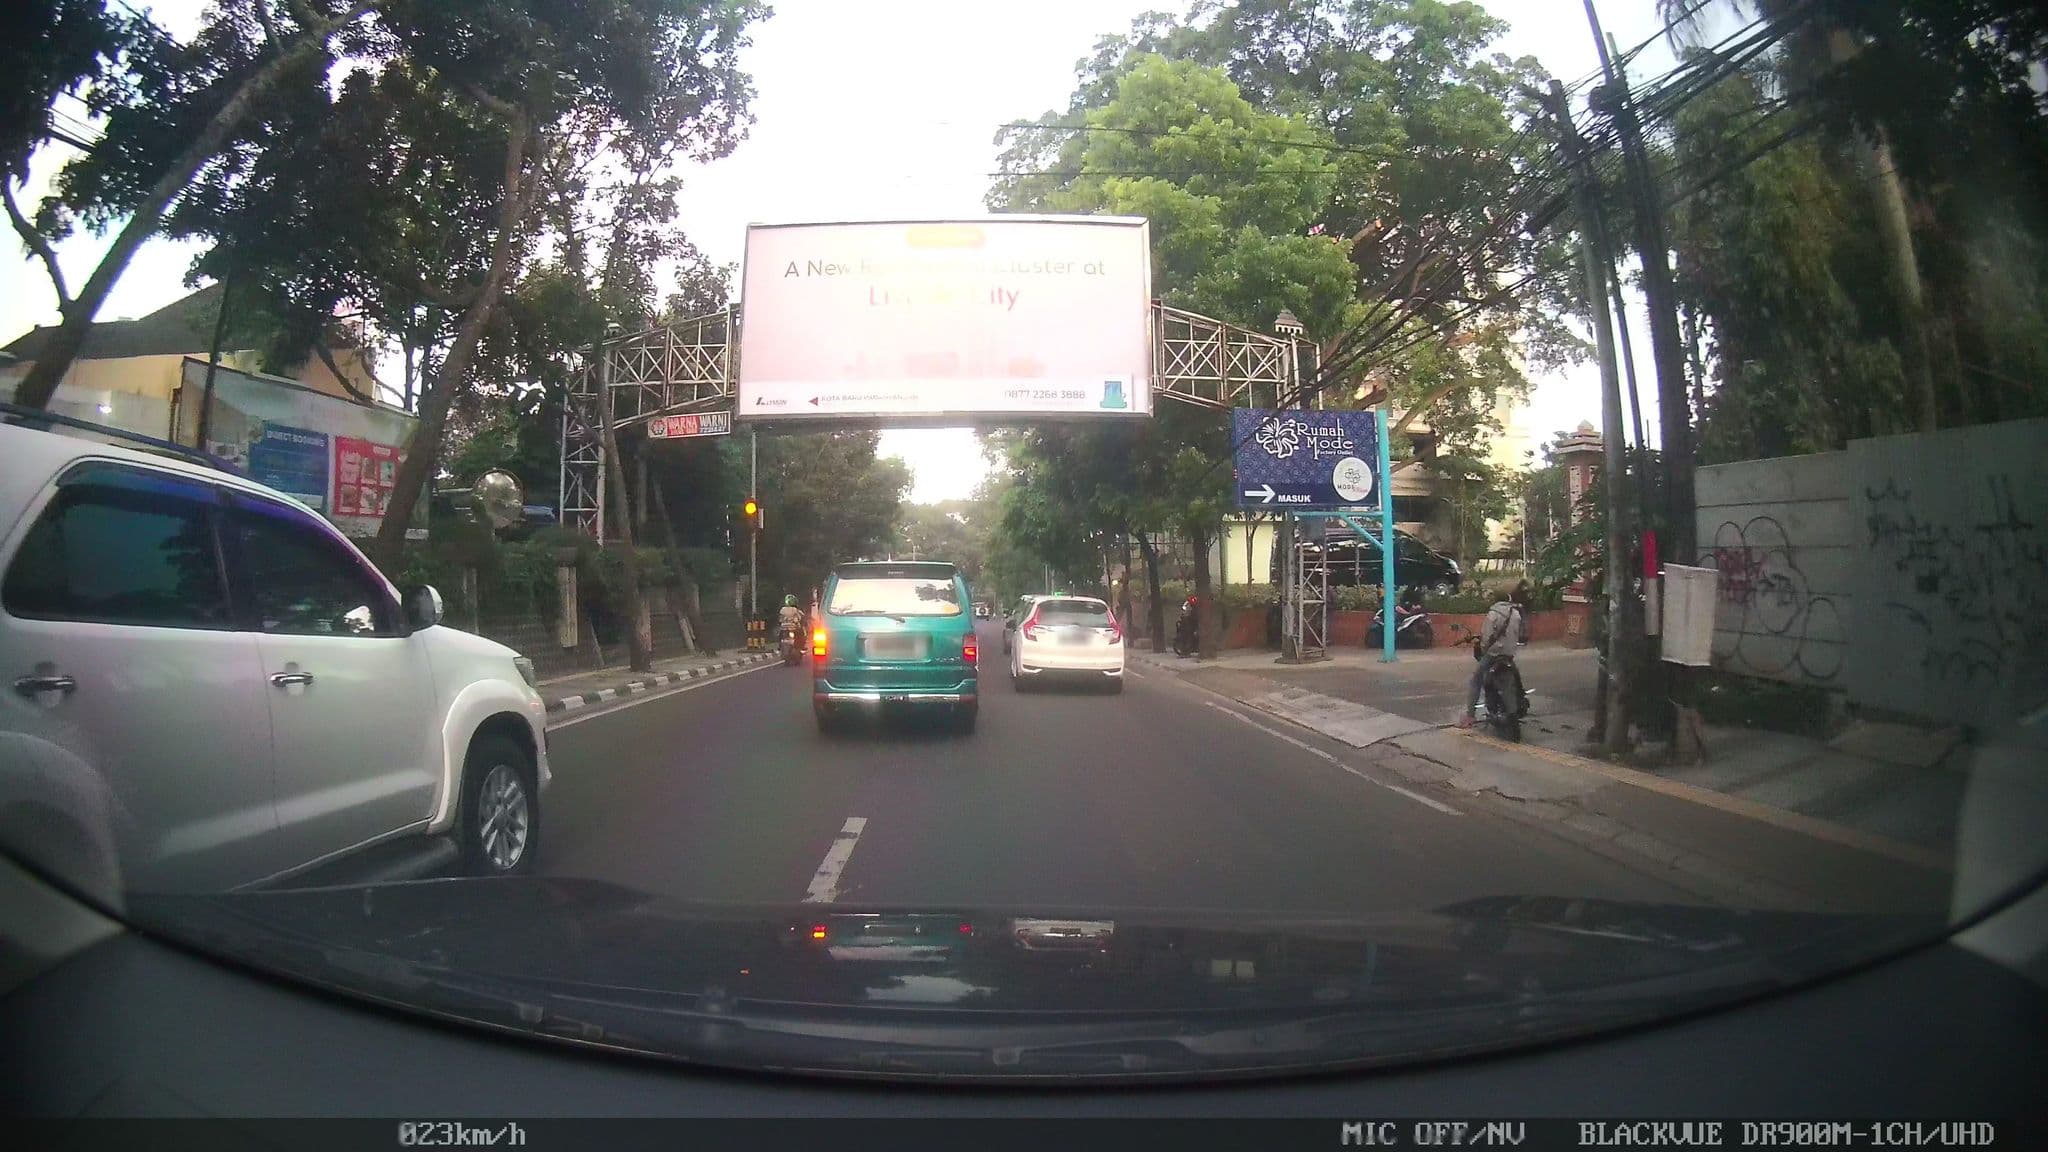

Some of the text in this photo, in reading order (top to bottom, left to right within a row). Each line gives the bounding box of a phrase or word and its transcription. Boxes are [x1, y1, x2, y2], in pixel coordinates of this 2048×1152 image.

[784, 260, 800, 278] A
[807, 259, 850, 277] New
[999, 260, 1076, 275] luster
[1084, 260, 1105, 276] at
[1033, 389, 1058, 399] 2268
[668, 415, 698, 429] WARNA
[700, 414, 727, 427] WARNI
[1296, 418, 1345, 437] Rumah
[1306, 436, 1354, 460] Mode
[1278, 494, 1312, 503] MASUK
